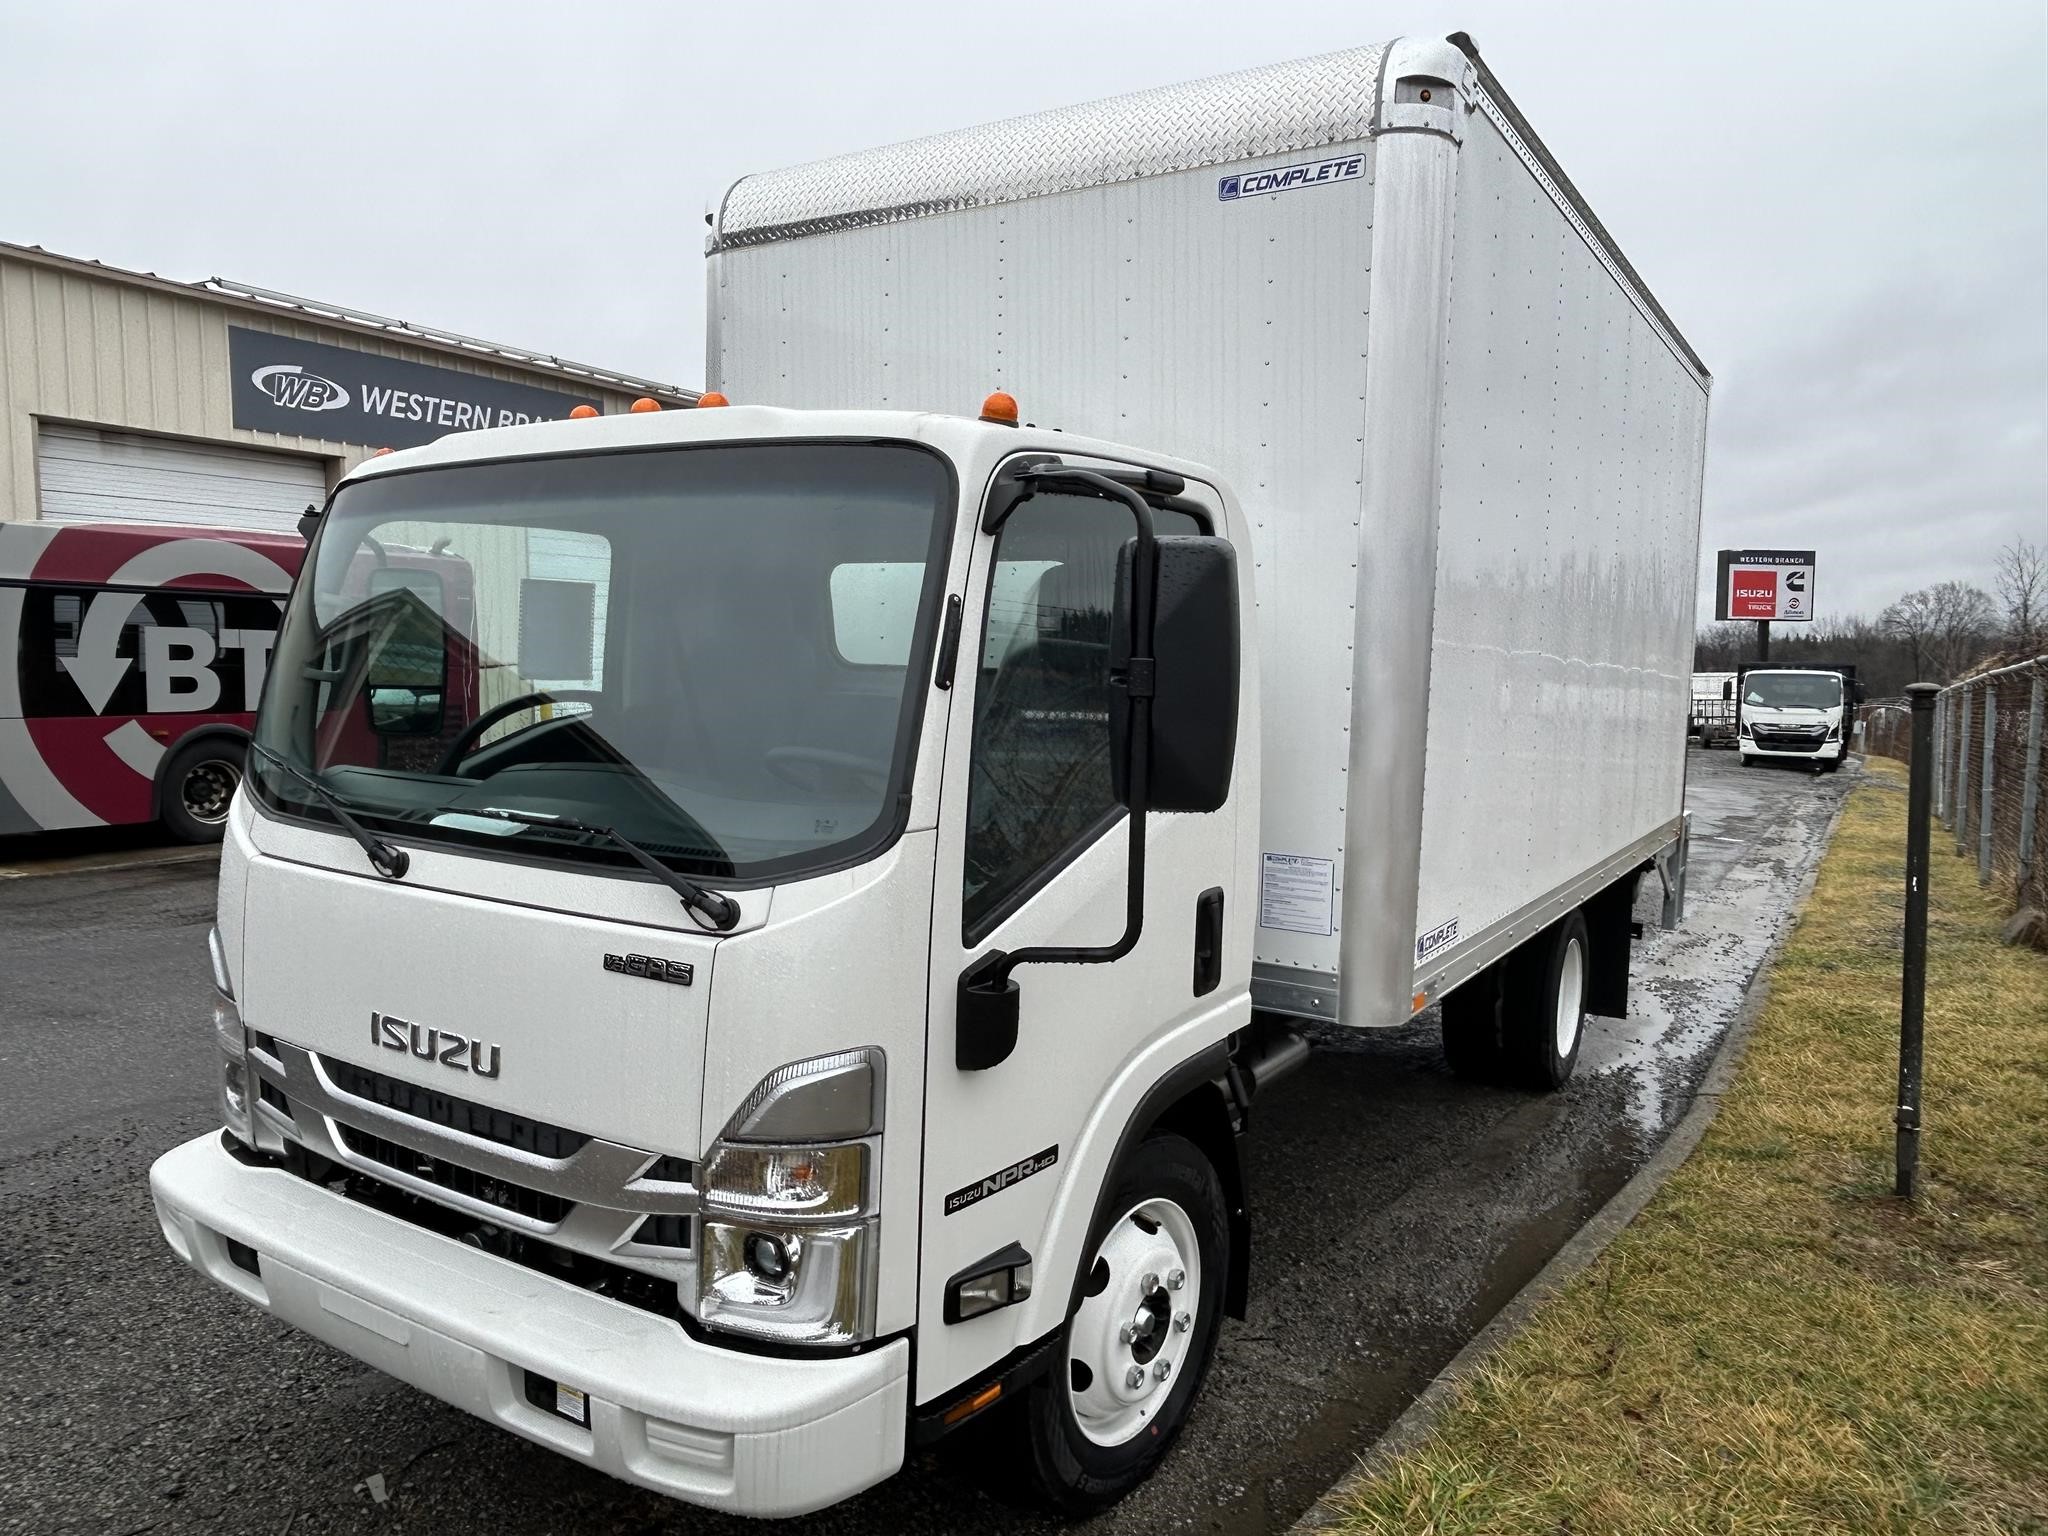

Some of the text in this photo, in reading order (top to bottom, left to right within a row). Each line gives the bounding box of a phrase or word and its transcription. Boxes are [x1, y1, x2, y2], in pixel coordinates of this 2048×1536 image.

[1242, 158, 1362, 194] COMPLETE
[273, 373, 330, 412] WB
[361, 384, 492, 430] WESTERN
[1736, 589, 1773, 598] ISUZU
[1424, 921, 1458, 951] COMPLETE
[371, 1010, 501, 1080] ISUZU
[949, 1187, 981, 1209] ISUZU
[982, 1159, 1035, 1196] NPR
